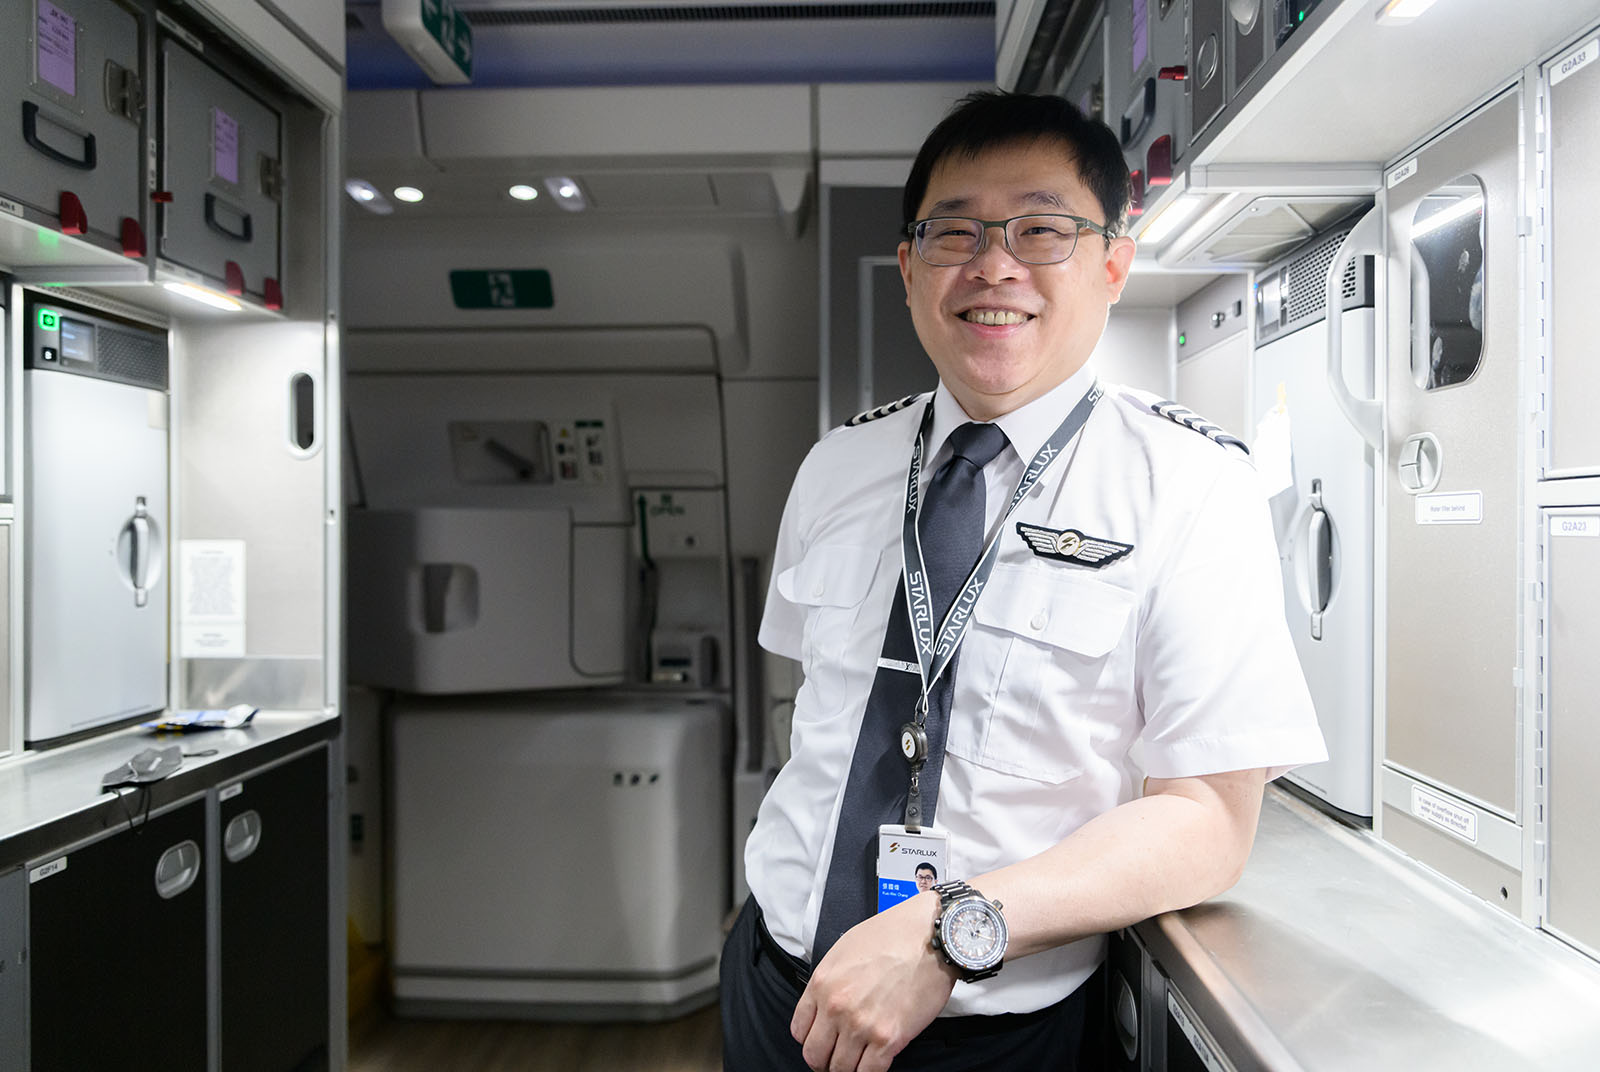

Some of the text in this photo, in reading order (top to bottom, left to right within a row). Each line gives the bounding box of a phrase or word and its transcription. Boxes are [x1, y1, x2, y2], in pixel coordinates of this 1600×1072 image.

[1561, 51, 1586, 74] G2A33
[1562, 521, 1587, 531] G2A23
[909, 570, 932, 655] STARLUX
[936, 577, 984, 657] STARLUX
[901, 847, 937, 857] STARLUX
